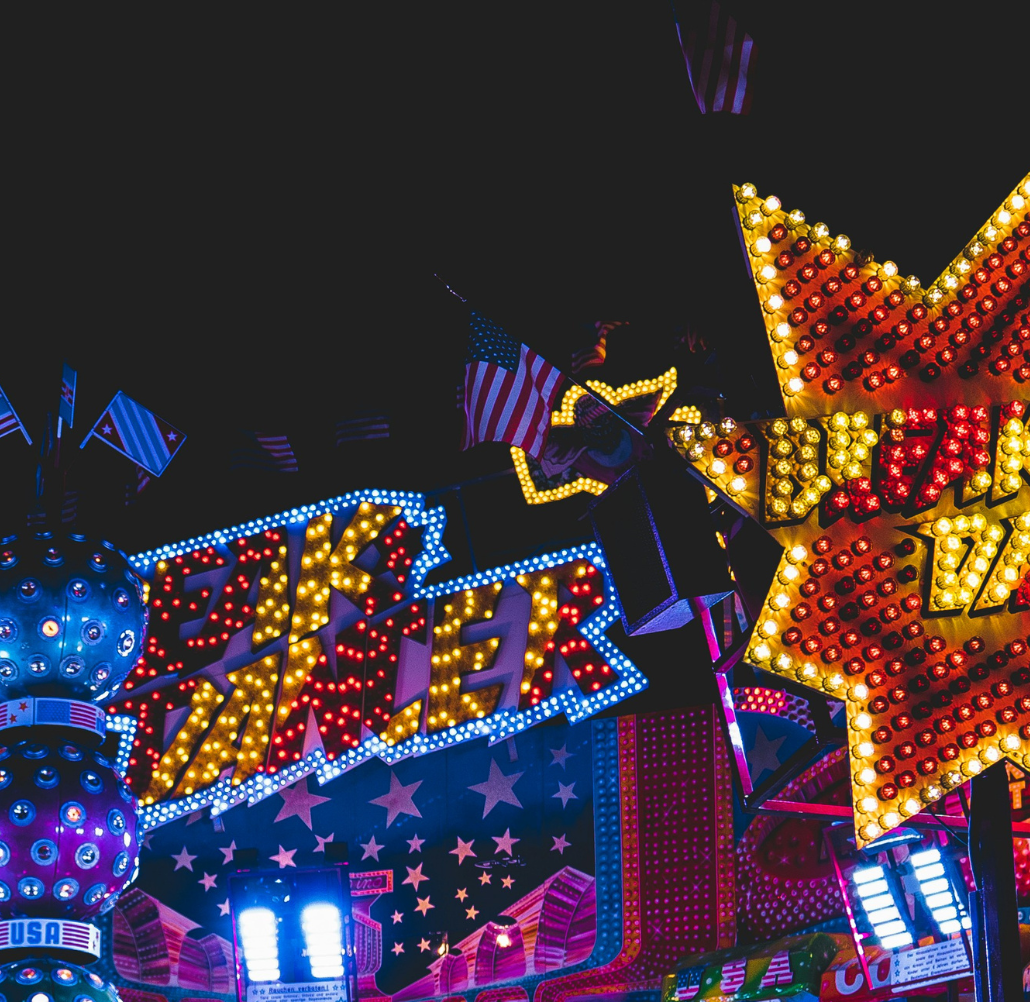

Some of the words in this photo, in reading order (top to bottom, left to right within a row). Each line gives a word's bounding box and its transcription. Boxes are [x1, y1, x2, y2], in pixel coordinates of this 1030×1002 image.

[110, 558, 622, 806] DANCER
[10, 921, 60, 946] USA
[673, 950, 793, 1000] USA
